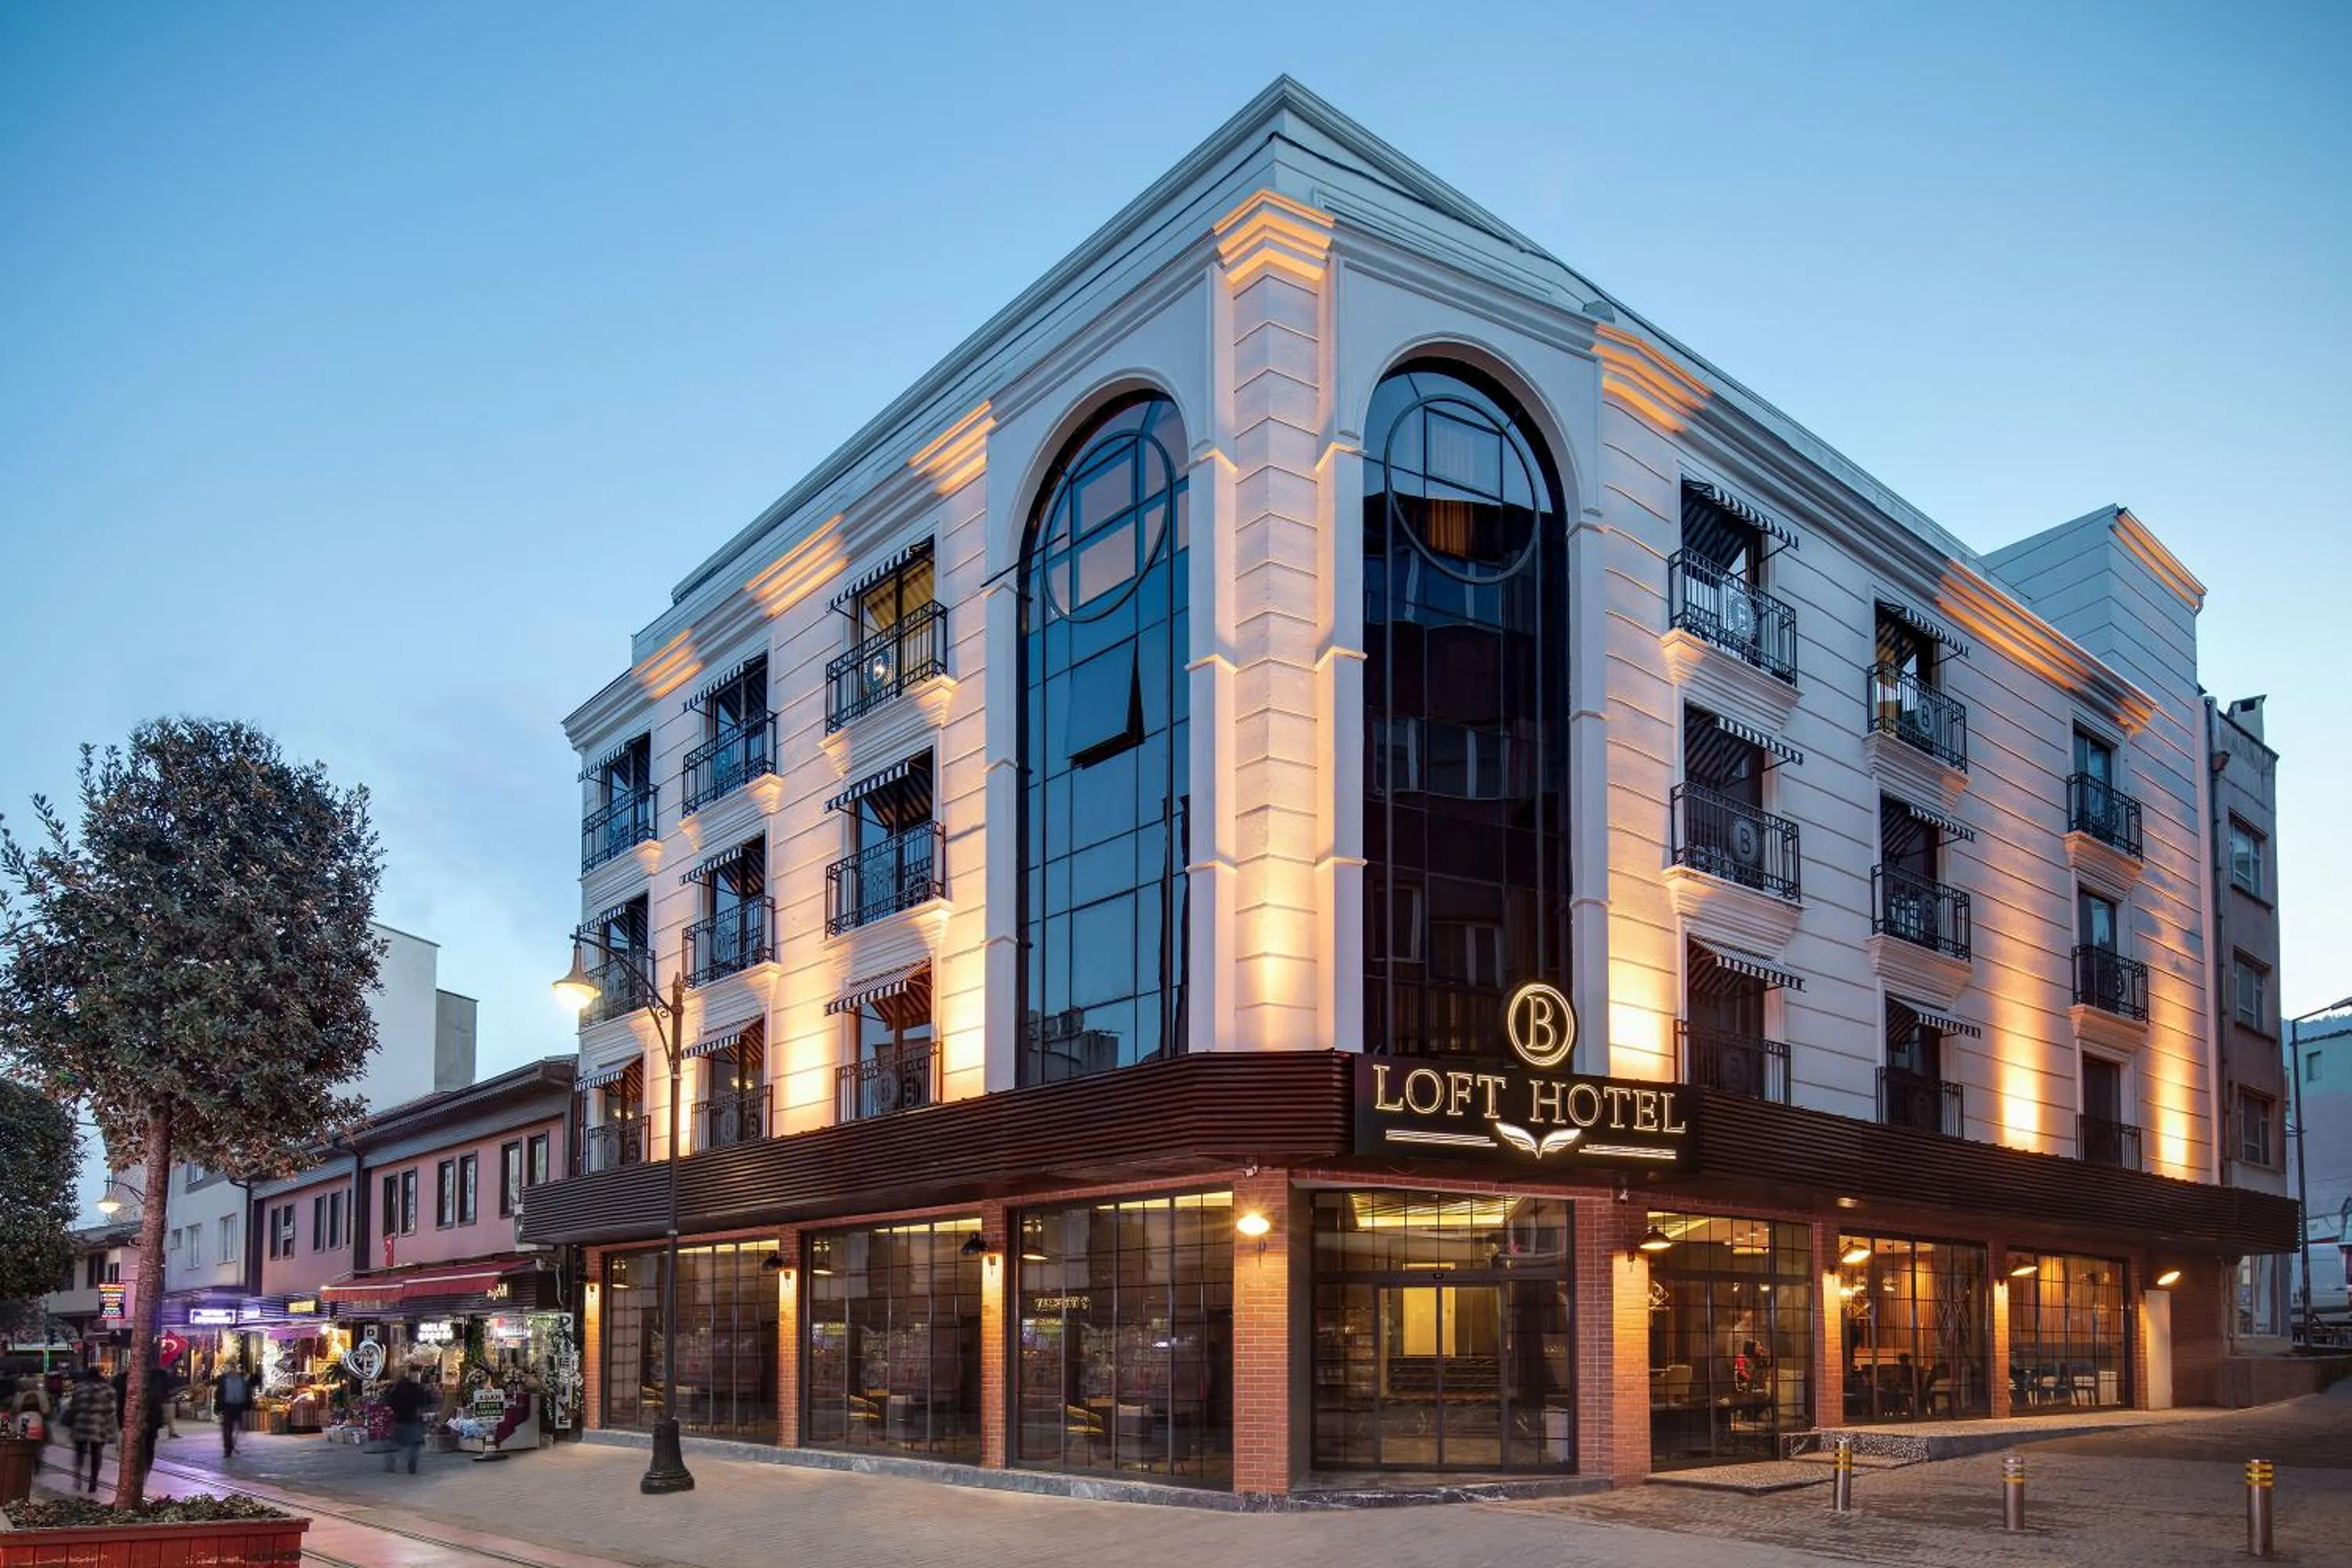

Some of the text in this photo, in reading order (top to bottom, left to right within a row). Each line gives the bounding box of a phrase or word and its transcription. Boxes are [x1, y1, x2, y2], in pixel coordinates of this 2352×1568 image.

[873, 655, 885, 681] B
[1740, 826, 1751, 855] B
[1526, 995, 1558, 1051] B
[1373, 1063, 1686, 1134] LOFT HOTEL
